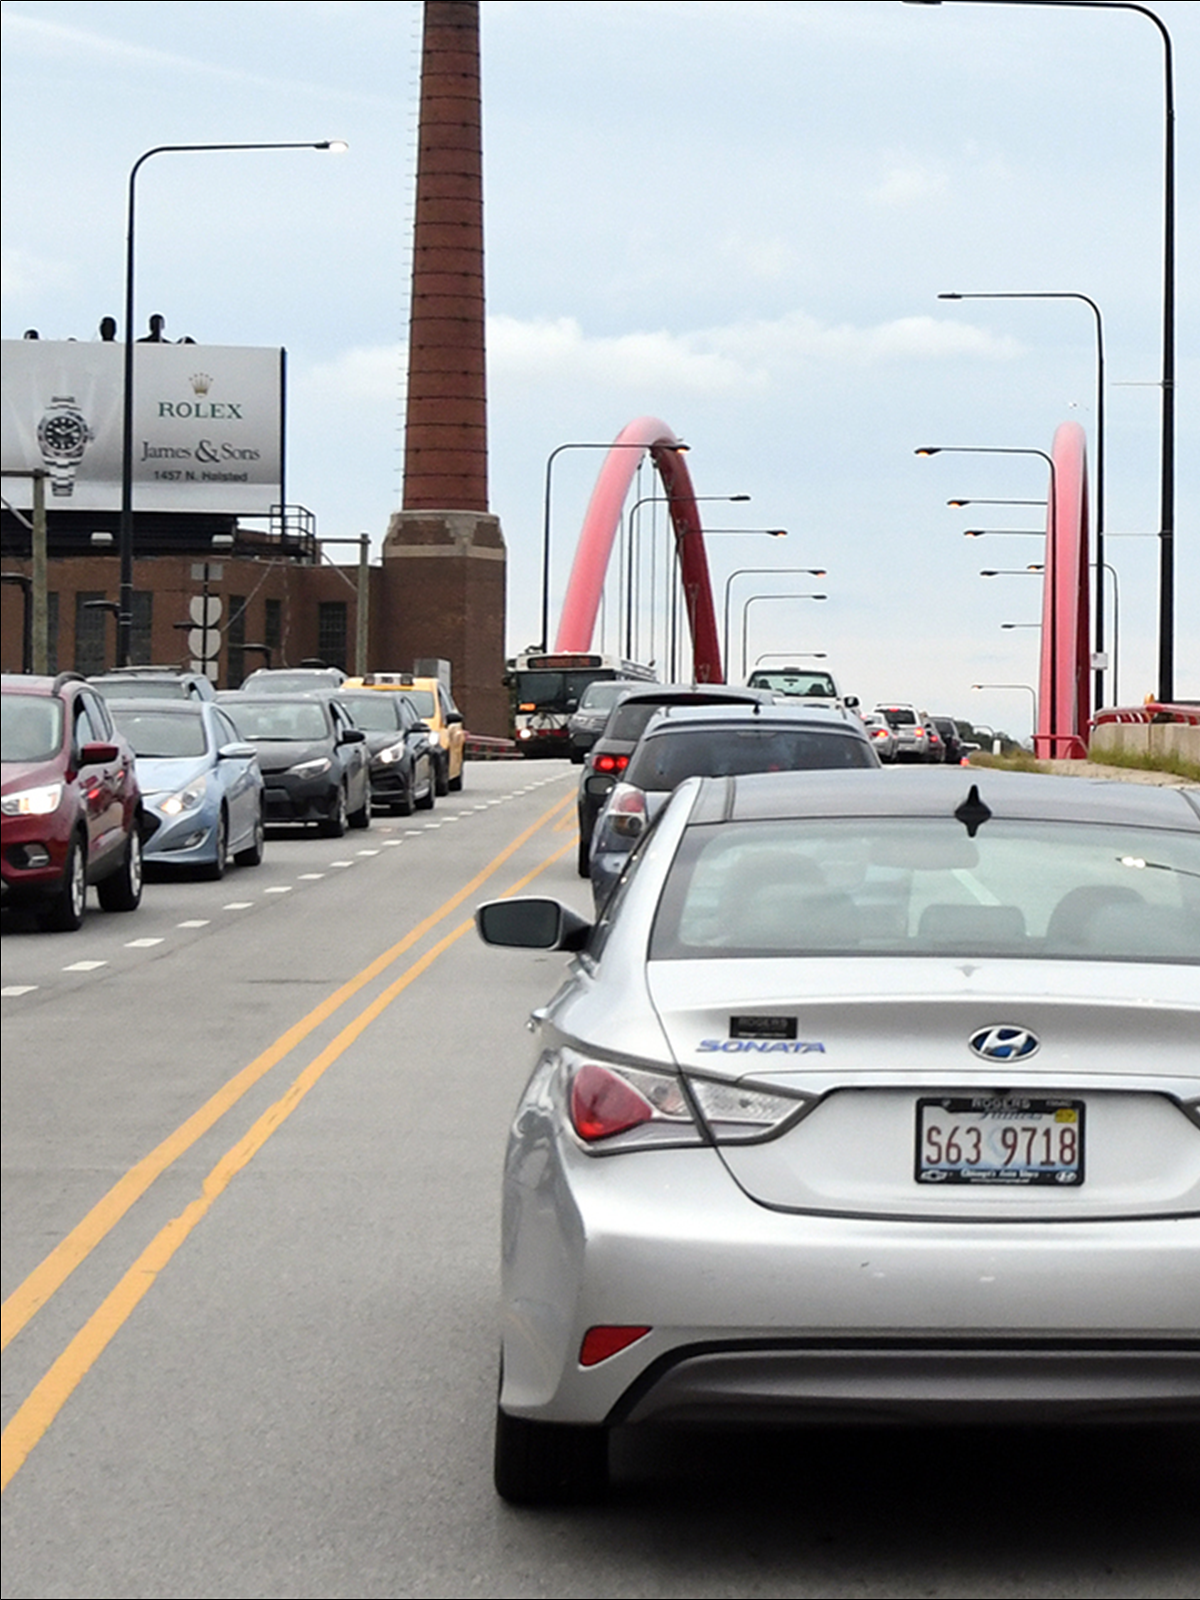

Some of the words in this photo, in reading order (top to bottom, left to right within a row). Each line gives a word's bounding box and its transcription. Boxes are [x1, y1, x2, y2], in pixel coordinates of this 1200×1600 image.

[158, 402, 242, 419] ROLEX
[141, 441, 192, 461] James
[195, 440, 220, 463] &
[221, 443, 261, 460] Sons
[201, 471, 248, 481] Halsted
[695, 1040, 826, 1053] SONATA
[971, 1098, 1031, 1109] ROGERS
[926, 1126, 982, 1165] S63
[1001, 1127, 1076, 1166] 9718
